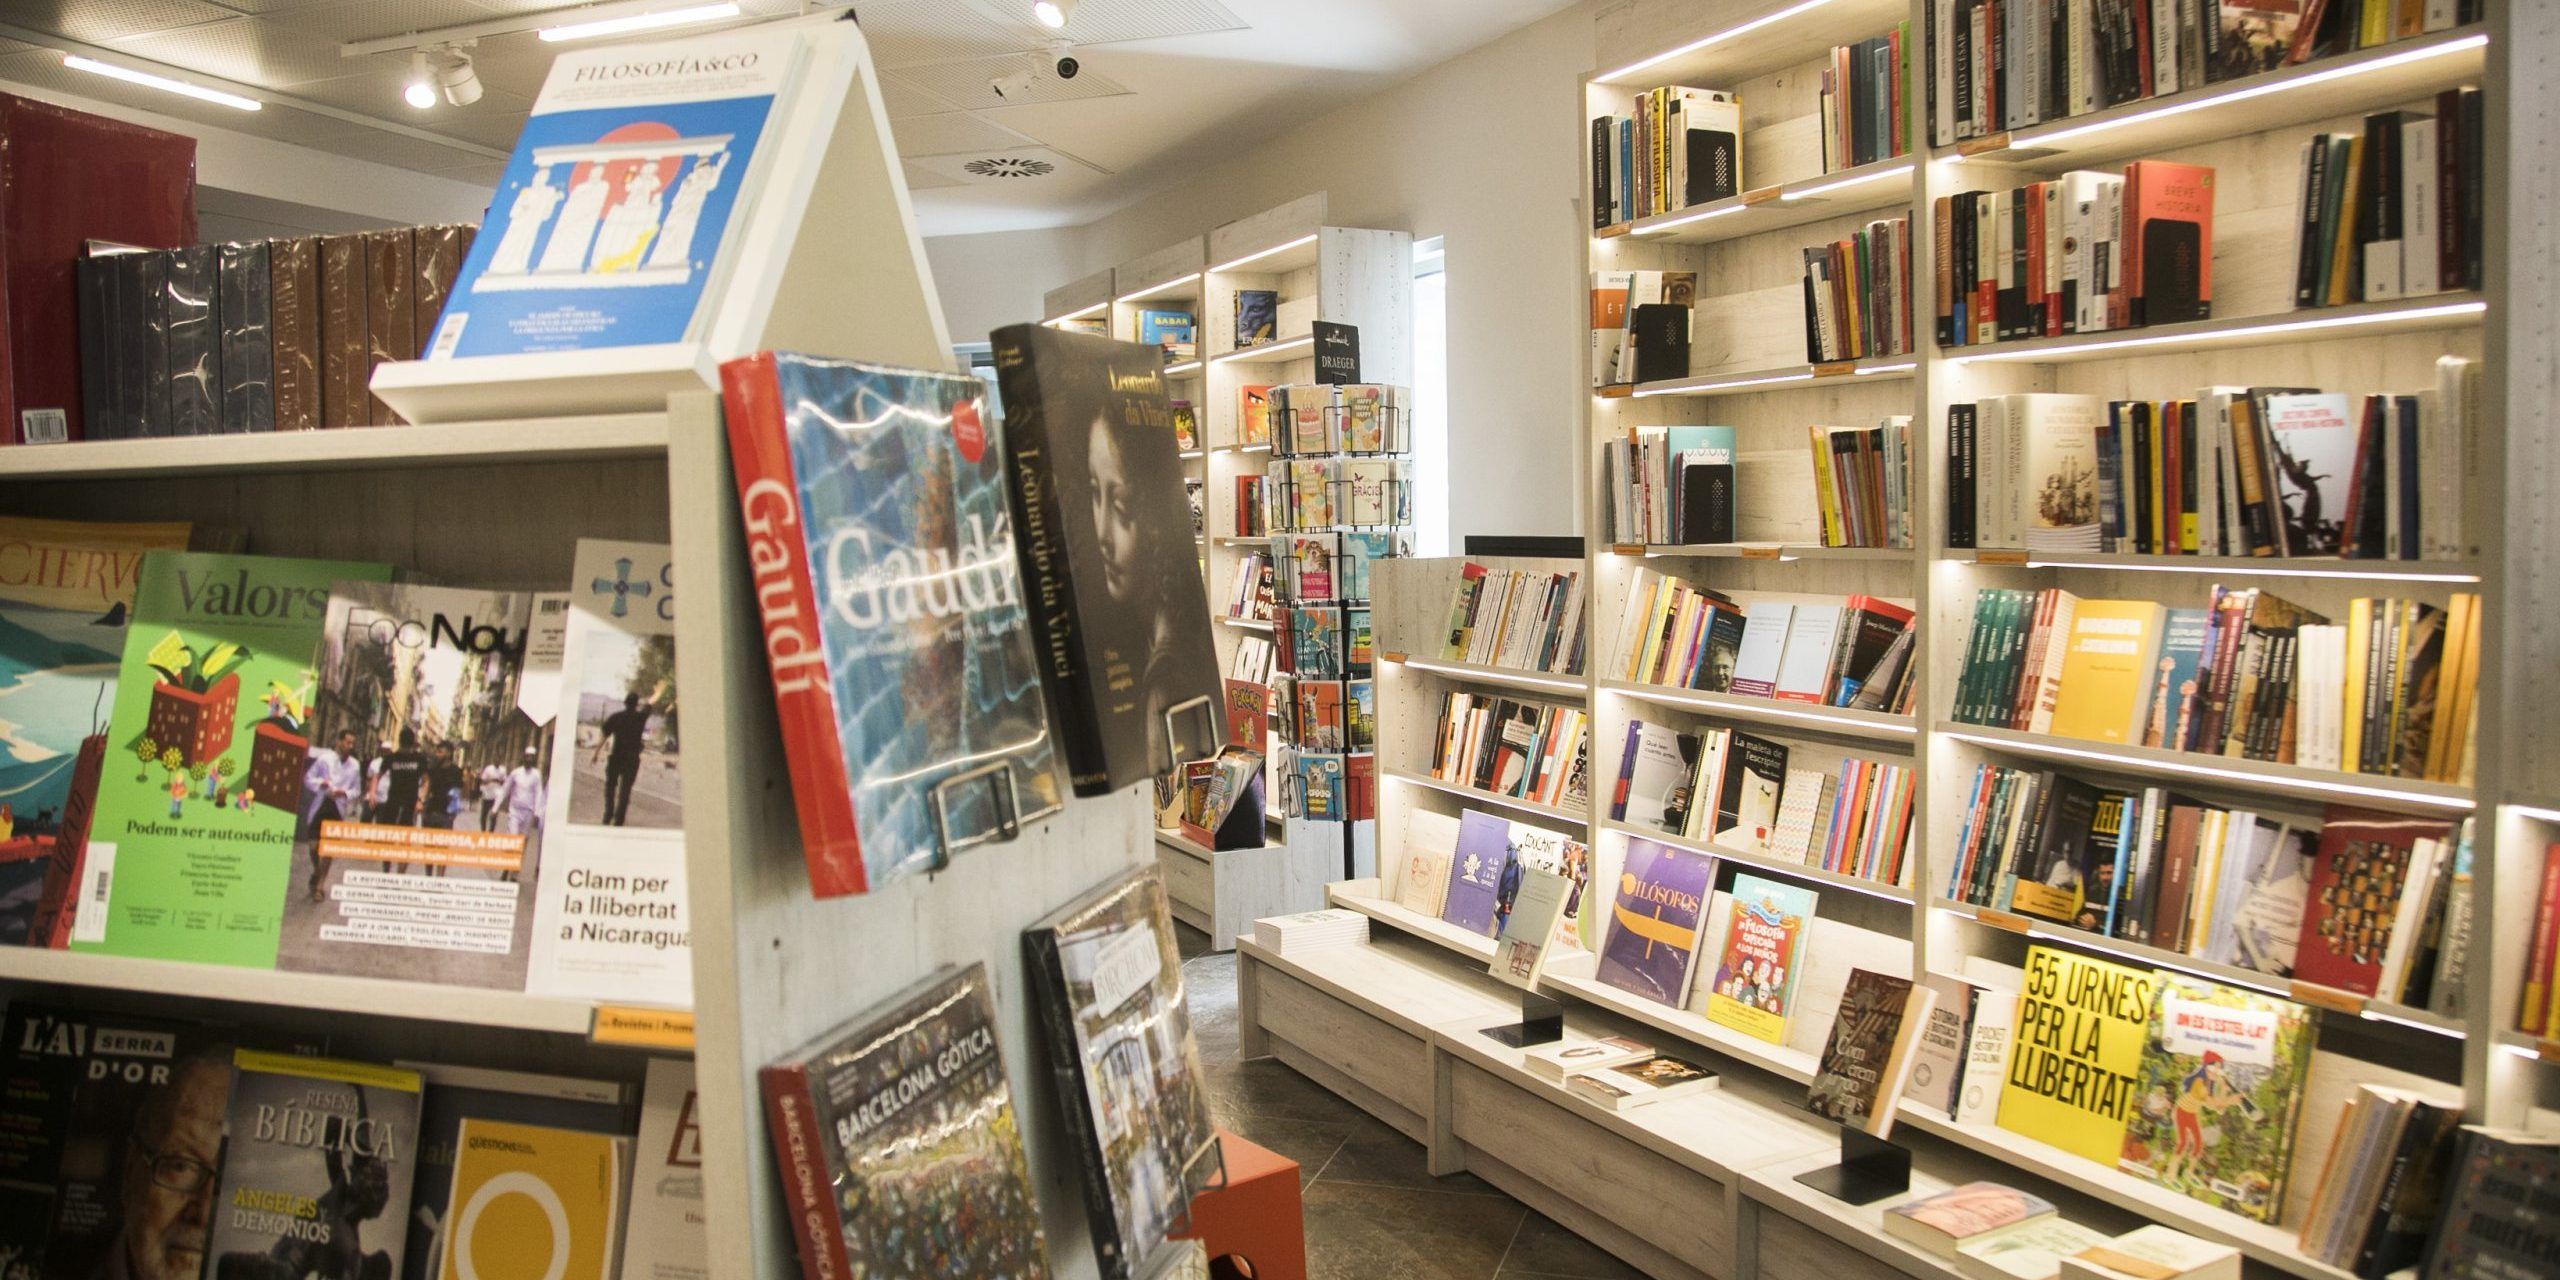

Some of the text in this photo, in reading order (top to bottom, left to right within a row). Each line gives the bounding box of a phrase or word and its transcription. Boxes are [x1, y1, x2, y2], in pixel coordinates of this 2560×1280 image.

[574, 52, 759, 83] FILOSOFÍA&CO
[2164, 185, 2196, 198] BREVE
[1155, 316, 1188, 326] BABAR
[1321, 355, 1355, 369] DRAEGER
[1106, 367, 1164, 395] Leonardo
[824, 510, 1022, 631] Gaudí
[1016, 448, 1073, 679] Leonardo da Vinci
[178, 568, 329, 621] Valors
[744, 477, 831, 698] Gaudí
[1734, 737, 1783, 758] La maleta de
[126, 819, 178, 837] Podem
[181, 825, 205, 838] ser
[326, 826, 340, 837] LA
[344, 827, 408, 843] LLIBERTAT
[411, 832, 475, 849] RELIGIOSA,
[567, 868, 669, 896] Clam per
[563, 895, 677, 920] la llibertat
[560, 922, 693, 950] a Nicaragua
[2028, 952, 2149, 1025] 55 URNES
[100, 1035, 167, 1053] SERRA
[2018, 998, 2100, 1063] PER LA
[88, 1060, 171, 1085] D'OR
[2010, 1043, 2136, 1122] LLIBERTAT
[306, 1088, 359, 1113] RESEÑA
[835, 1066, 936, 1150] BARCELONA
[936, 1024, 994, 1079] GÒTICA
[253, 1098, 398, 1162] BÍBLICA
[779, 1094, 816, 1208] BARCELONA
[231, 1208, 331, 1246] DEMONIOS
